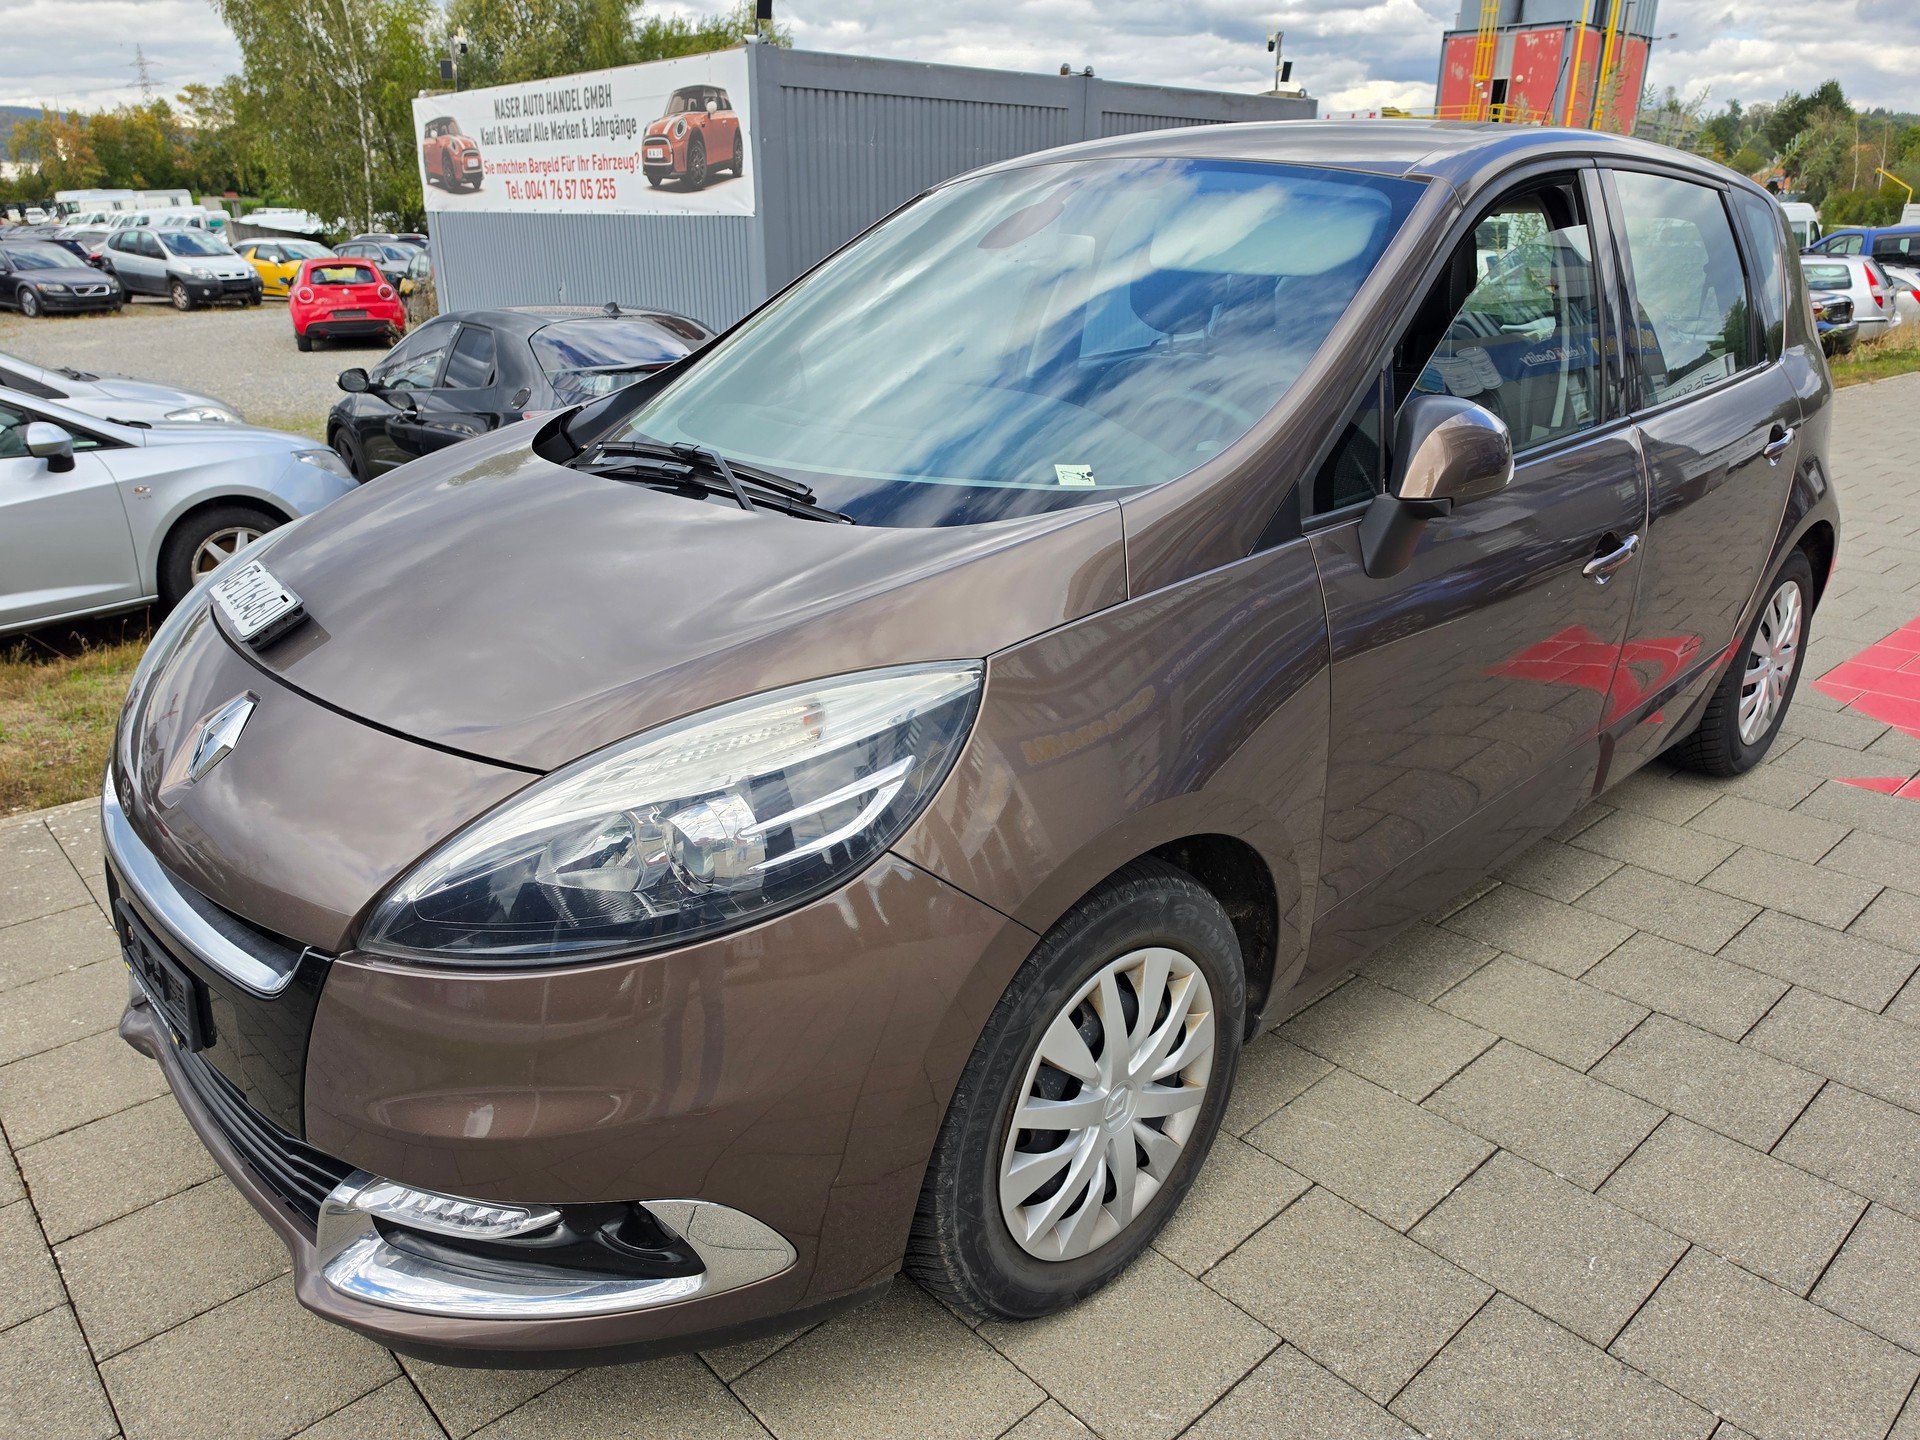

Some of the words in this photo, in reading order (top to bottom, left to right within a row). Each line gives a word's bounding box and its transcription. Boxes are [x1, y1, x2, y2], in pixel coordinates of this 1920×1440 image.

[494, 96, 521, 120] NASER
[523, 93, 545, 117] AUTO
[546, 88, 582, 114] HANDEL
[584, 83, 612, 110] GMBH
[480, 126, 496, 146] Kauf
[498, 126, 504, 145] &
[503, 123, 532, 144] Verkauf
[534, 121, 549, 142] Alle
[550, 119, 580, 141] Marken
[582, 117, 589, 138] &
[590, 114, 637, 141] Jahrgänge
[484, 159, 495, 175] Sie
[496, 158, 527, 174] möchten
[528, 156, 560, 177] Bargeld
[561, 155, 575, 172] Für
[577, 154, 589, 171] Ihr
[592, 152, 640, 174] Fahrzeug?
[505, 180, 523, 200] Tel:
[524, 180, 547, 200] 0041
[550, 179, 563, 200] 76
[565, 179, 576, 200] 57
[580, 178, 593, 200] 05
[595, 177, 617, 200] 255
